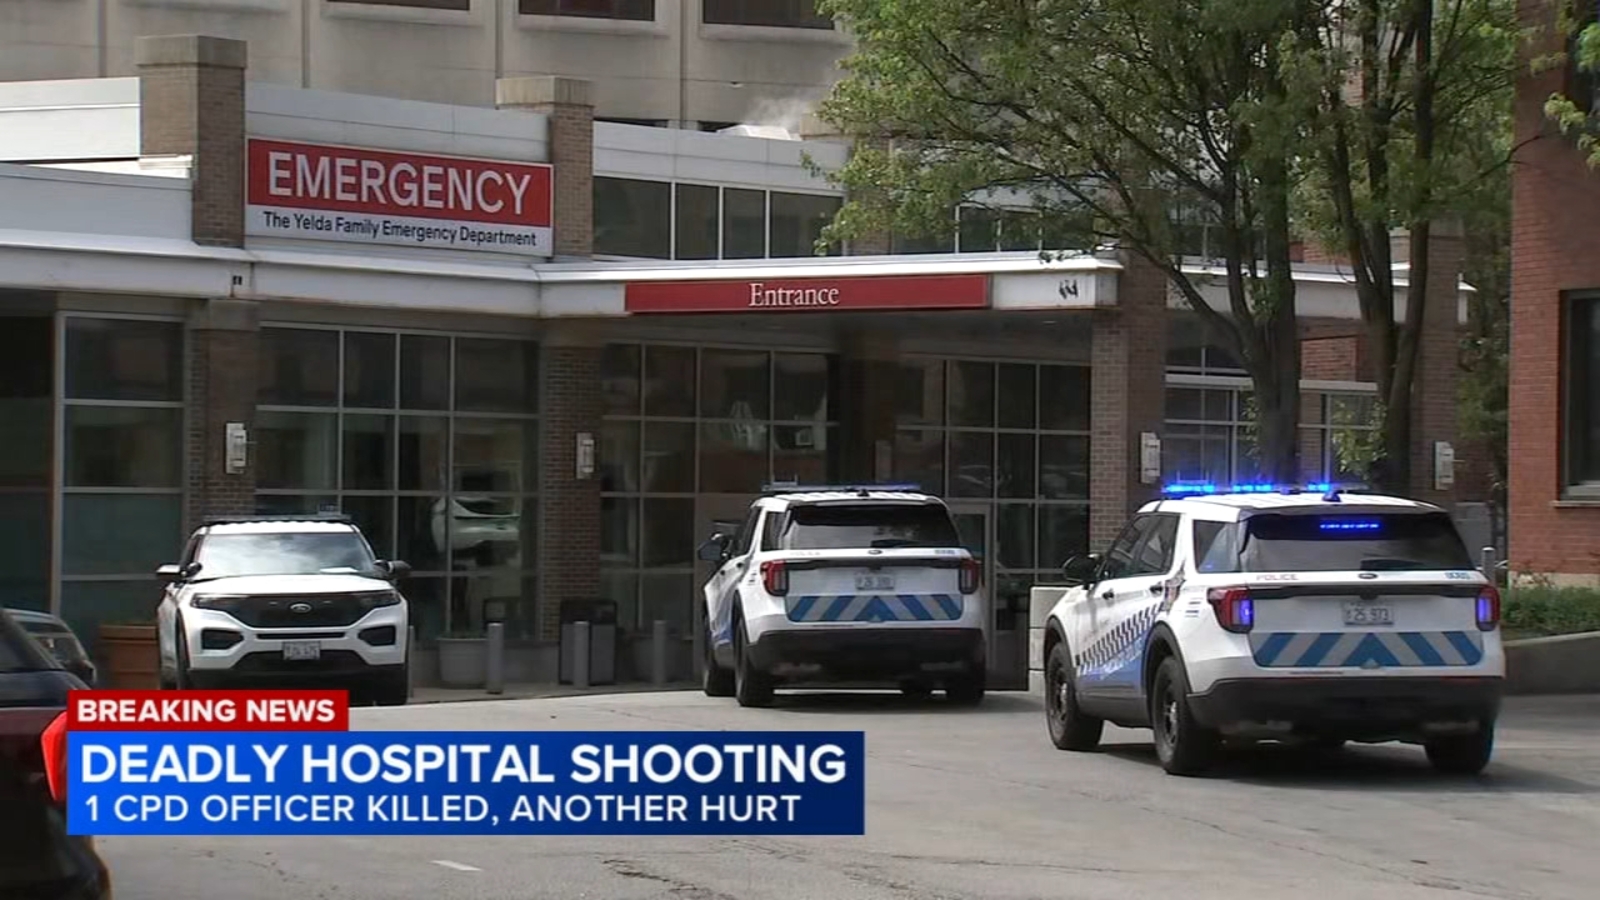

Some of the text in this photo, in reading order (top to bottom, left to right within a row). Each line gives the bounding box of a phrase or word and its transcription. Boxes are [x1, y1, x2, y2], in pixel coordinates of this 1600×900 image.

[269, 151, 531, 215] EMERGENCY
[263, 211, 537, 246] The Yelda Family Emergency Department
[749, 282, 839, 307] Entrance
[1256, 573, 1299, 581] POLICE
